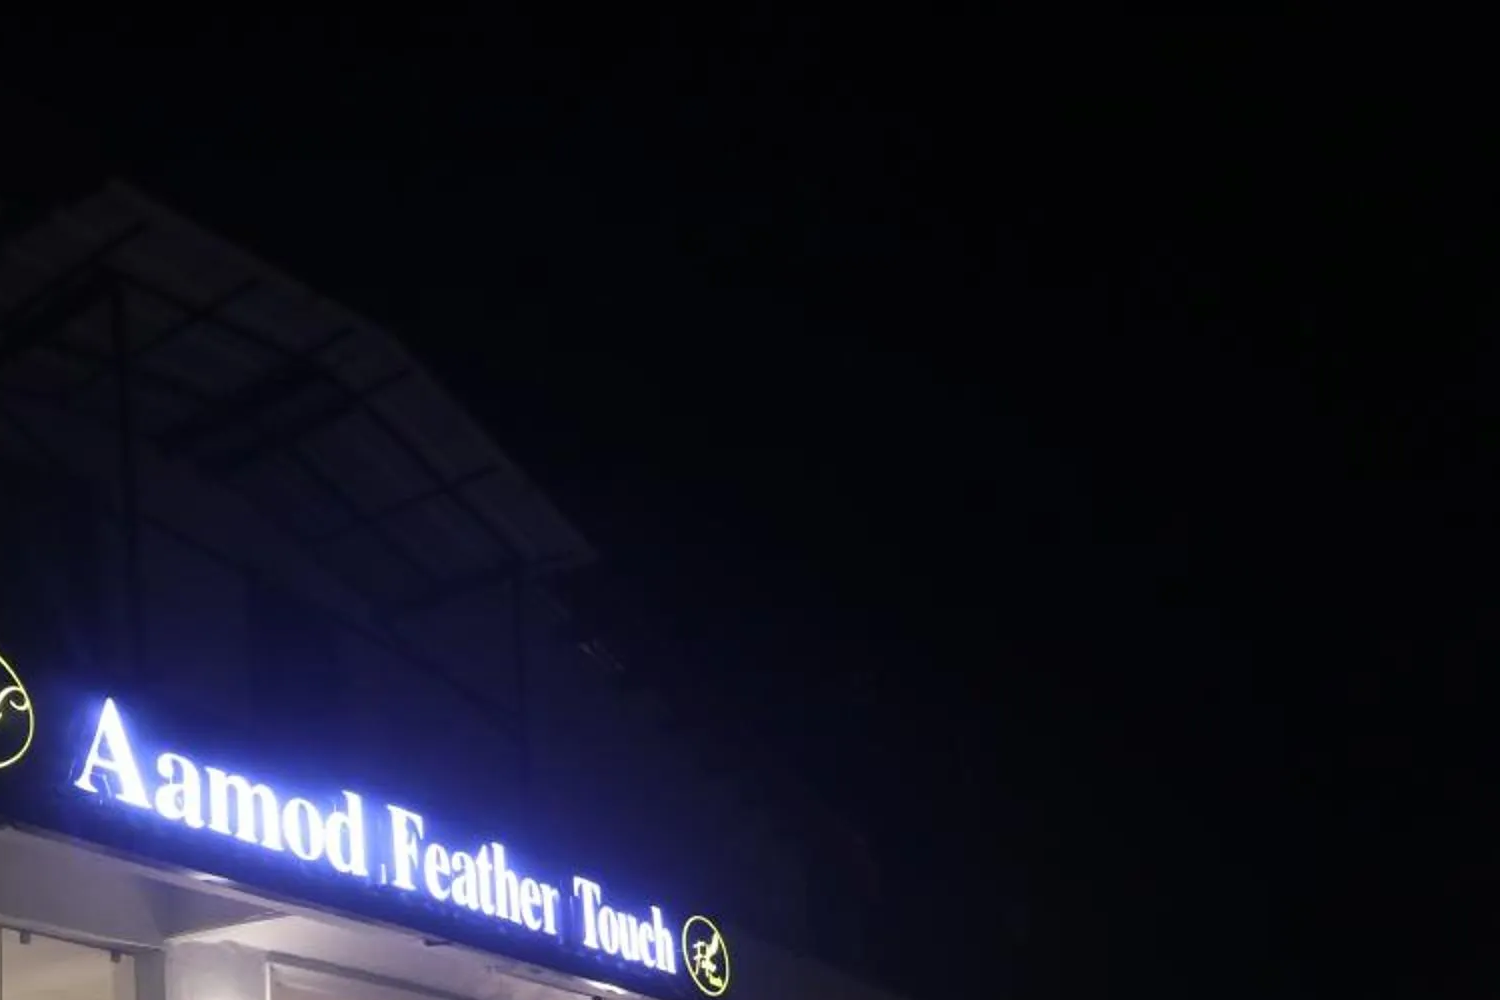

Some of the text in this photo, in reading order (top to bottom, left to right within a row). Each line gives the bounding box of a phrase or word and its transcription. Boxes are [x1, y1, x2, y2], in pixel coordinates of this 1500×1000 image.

[73, 697, 369, 876] Aamod
[387, 803, 560, 936] Feather
[573, 875, 677, 975] Touch
